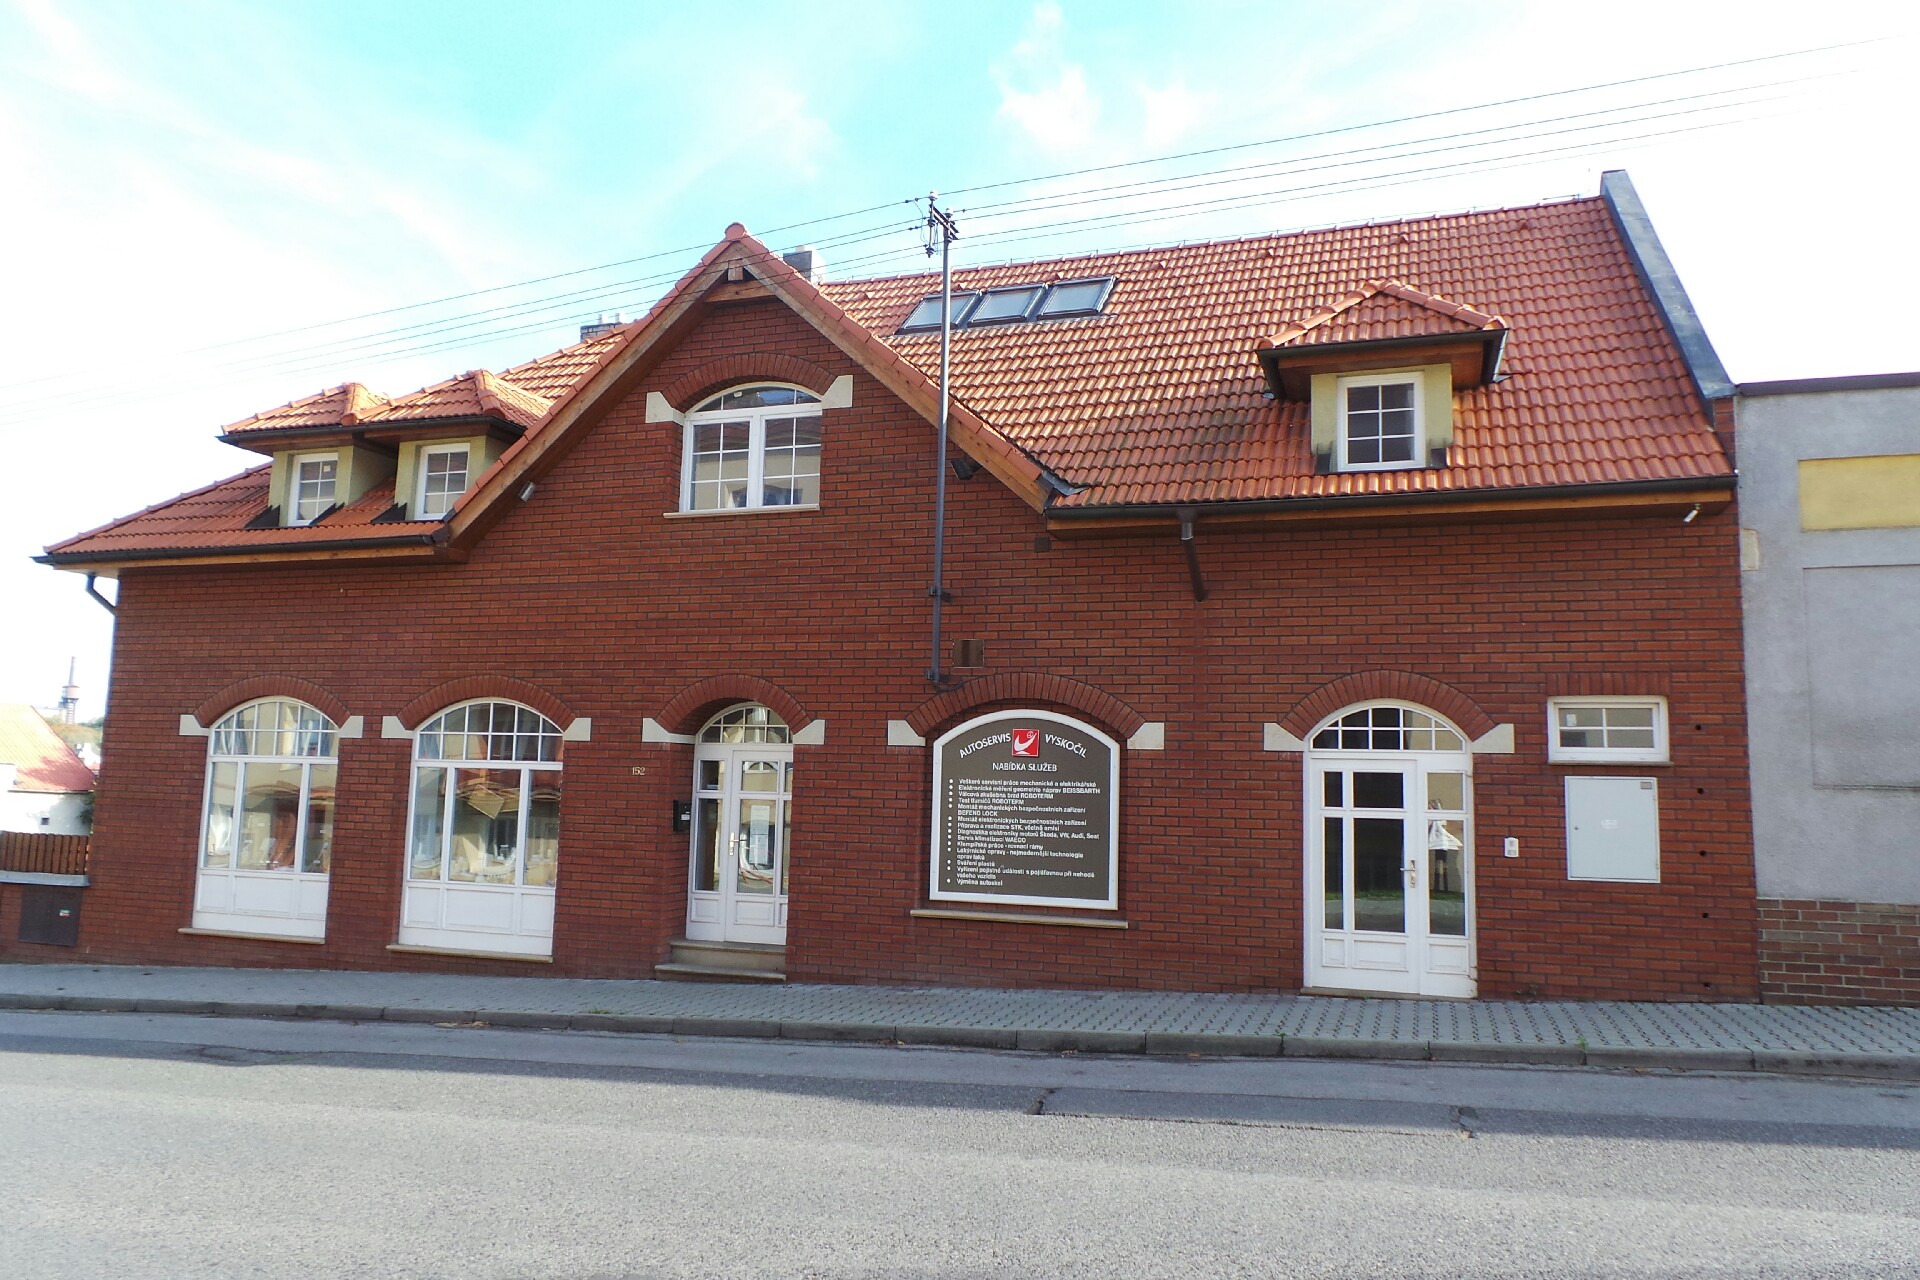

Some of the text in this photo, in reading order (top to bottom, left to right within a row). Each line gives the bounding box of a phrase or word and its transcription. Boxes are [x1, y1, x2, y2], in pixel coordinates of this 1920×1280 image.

[959, 733, 1087, 759] AUTOSERVIS VYSKOČIL
[632, 766, 646, 776] 152
[992, 762, 1058, 772] NABÍDKA SLUŽEB
